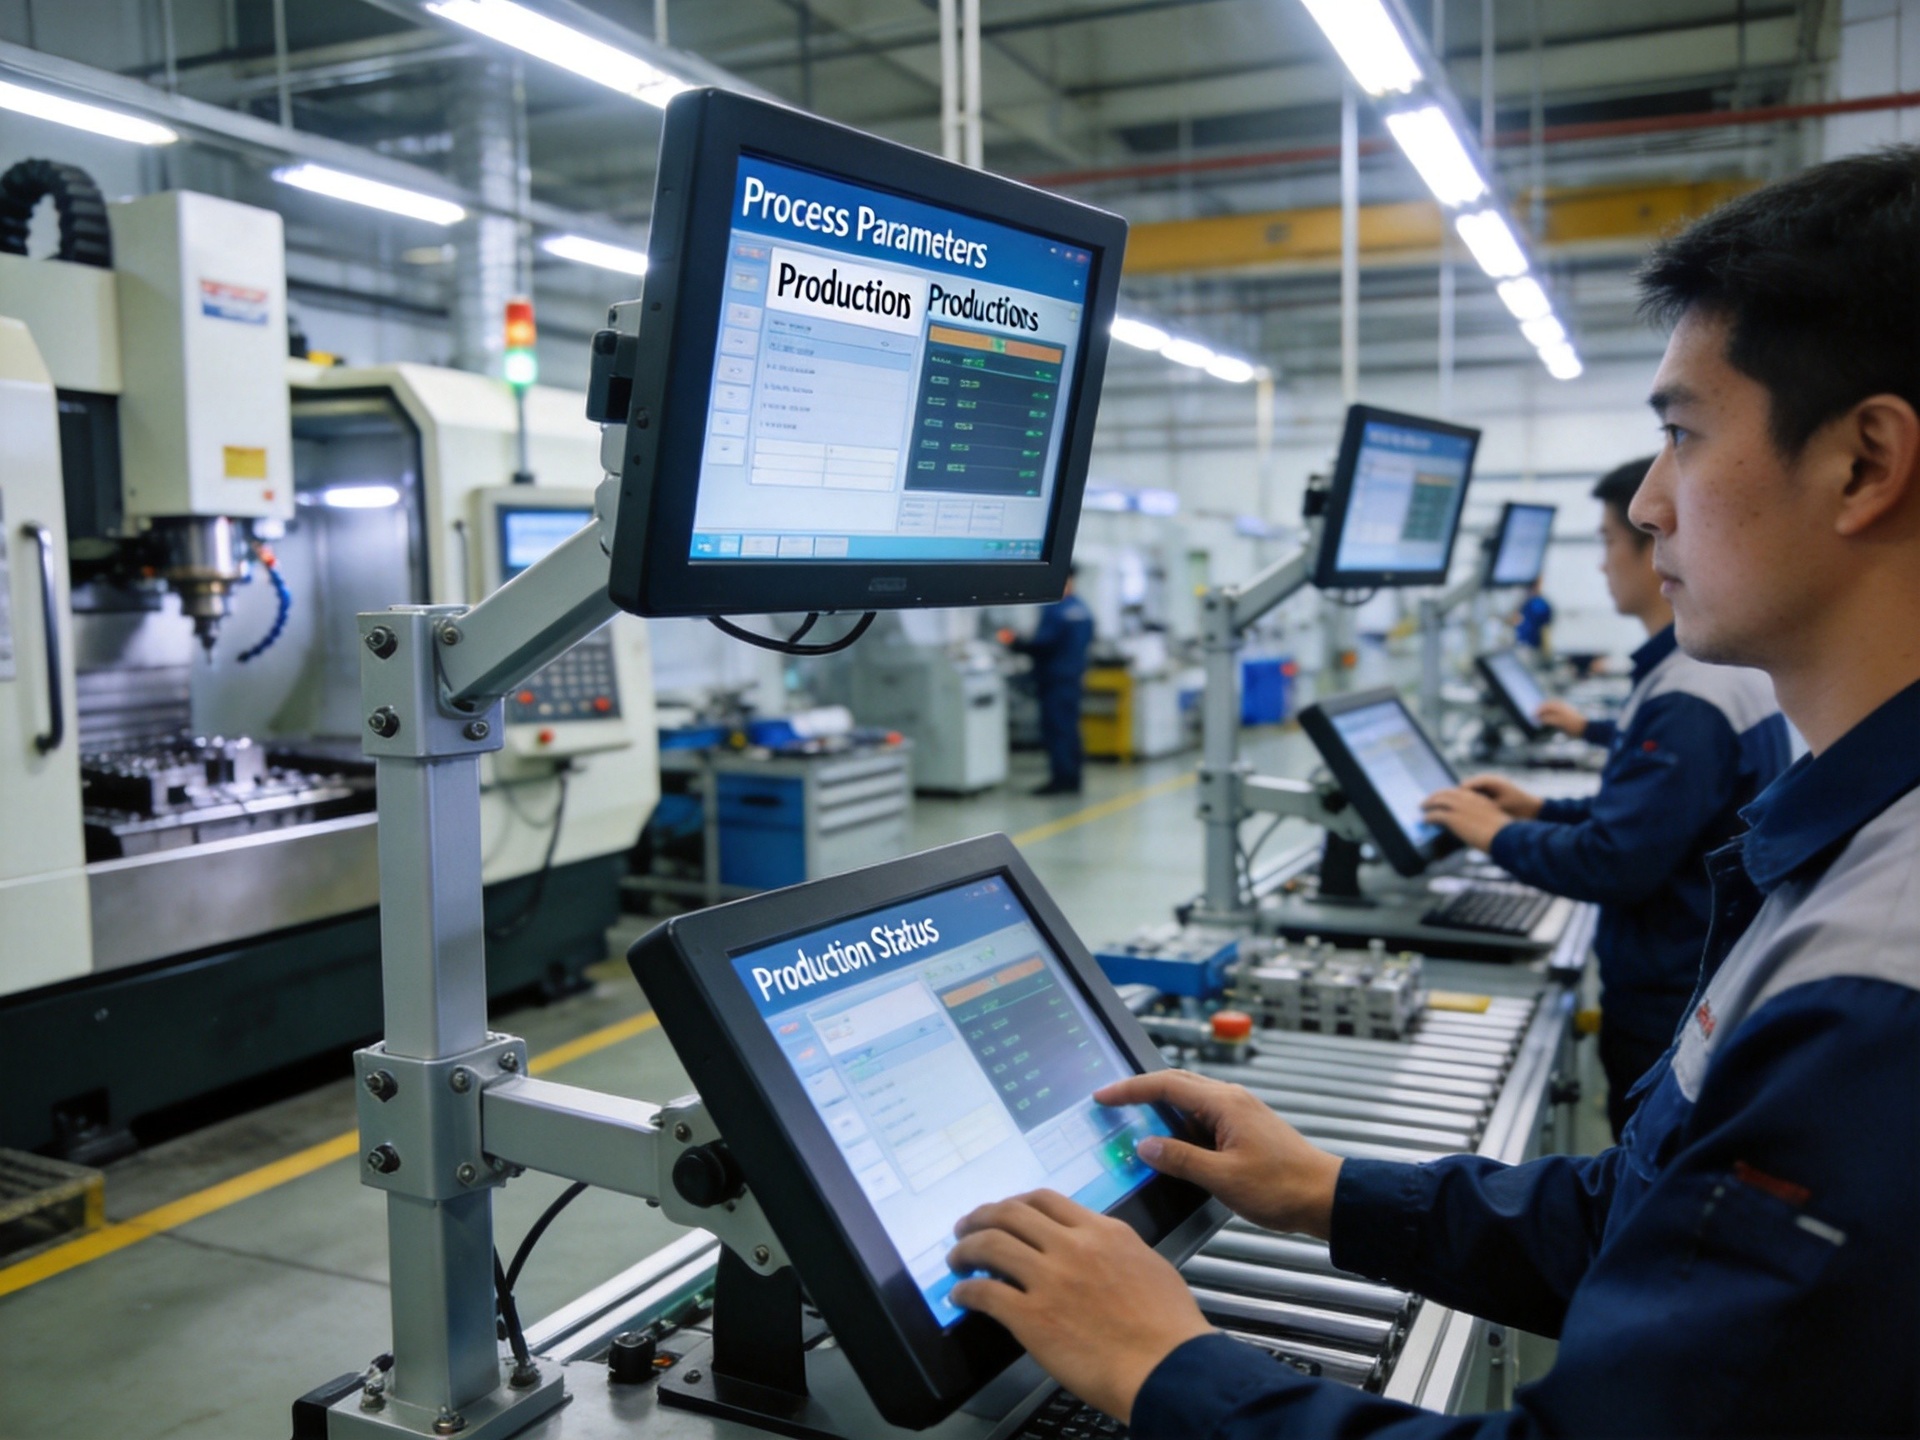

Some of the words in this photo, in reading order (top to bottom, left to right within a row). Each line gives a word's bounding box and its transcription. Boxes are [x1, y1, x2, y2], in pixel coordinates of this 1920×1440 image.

[742, 176, 849, 237] Process
[856, 205, 988, 269] Parameters
[777, 262, 911, 319] Production
[752, 940, 876, 1002] Production
[870, 918, 940, 959] Status
